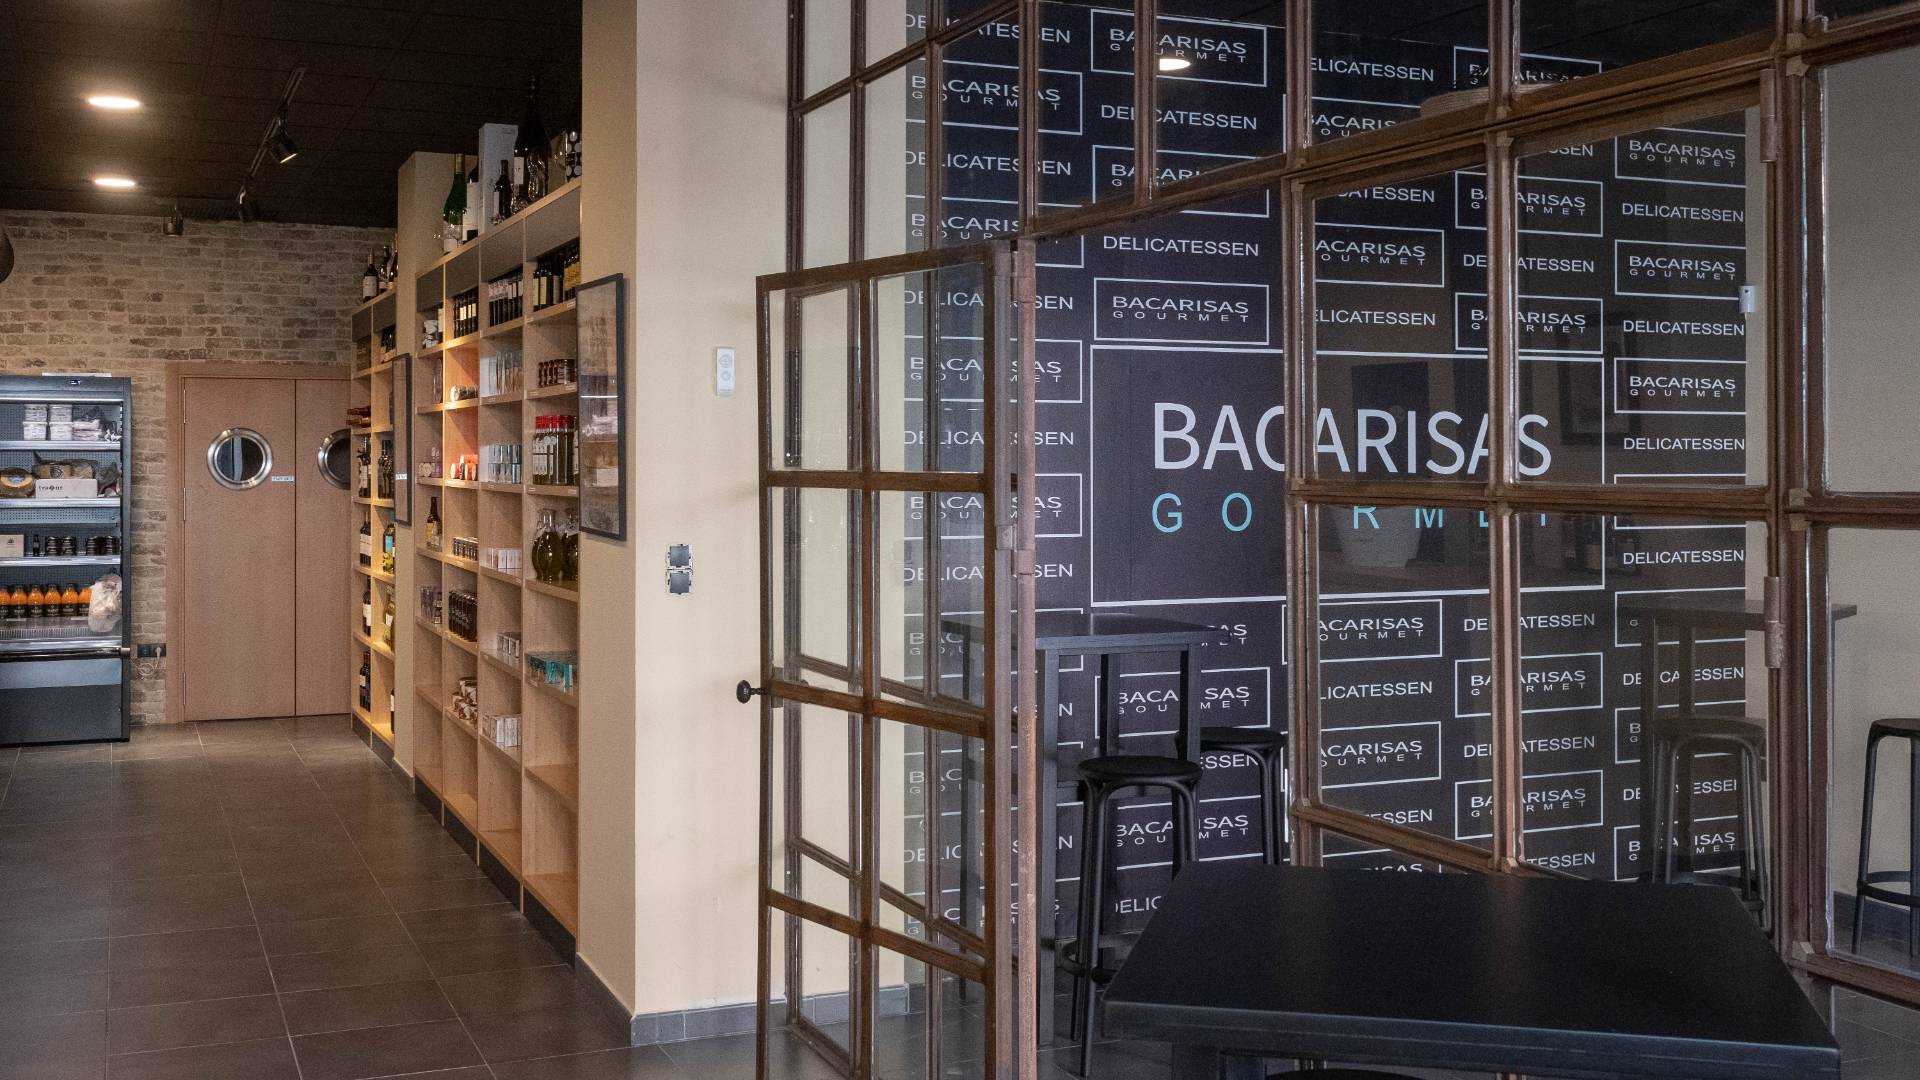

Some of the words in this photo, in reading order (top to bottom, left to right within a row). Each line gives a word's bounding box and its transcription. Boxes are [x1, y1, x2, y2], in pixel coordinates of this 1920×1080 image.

[1110, 28, 1247, 55] BARISAS
[1110, 43, 1247, 63] GURMET
[1311, 58, 1434, 82] ELICATESSEN
[912, 75, 1060, 101] BCARISS
[912, 92, 1060, 110] GURMT
[1101, 104, 1257, 130] DEATESSEN
[1630, 140, 1736, 160] BACARISAS
[906, 150, 1071, 176] DEICATESEN
[1630, 152, 1736, 168] GOURMET
[1471, 188, 1586, 208] BARISAS
[1471, 202, 1585, 216] GRMET
[1622, 203, 1744, 222] DELICATESSEN
[1104, 236, 1259, 256] DELICATESSEN
[1315, 240, 1426, 258] ACARISAS
[1322, 253, 1426, 266] OURMET
[1464, 254, 1594, 272] DEATESSEN
[1630, 256, 1736, 272] BACARISAS
[1630, 268, 1736, 280] GOURMET
[1112, 296, 1249, 314] BACARISAS
[1113, 310, 1248, 322] GOURMET
[1315, 308, 1436, 326] LICATESSEN
[1472, 310, 1586, 325] BARISAS
[1472, 322, 1586, 333] GRMET
[1623, 320, 1744, 336] DELICATESSEN
[1630, 376, 1736, 390] BACARISAS
[1630, 389, 1736, 398] GOURMET
[1624, 438, 1744, 450] DELICATESSEN
[1623, 550, 1744, 564] DELICATESSEN
[1319, 618, 1424, 632] ACARISAS
[1464, 614, 1595, 632] DEATESSEN
[1320, 630, 1424, 642] OURMET
[1471, 670, 1586, 686] BRISAS
[1120, 686, 1250, 704] BACASAS
[1320, 681, 1432, 700] ICATESSEN
[1471, 682, 1586, 696] GRMET
[1119, 700, 1250, 714] OUMET
[1321, 740, 1422, 758] CARISAS
[1464, 736, 1595, 758] DETESSEN
[1321, 752, 1422, 767] URMET
[1471, 788, 1586, 808] BRISAS
[1471, 800, 1585, 818] GRMET
[1117, 815, 1248, 837] BACASAS
[1117, 828, 1248, 847] OUMET
